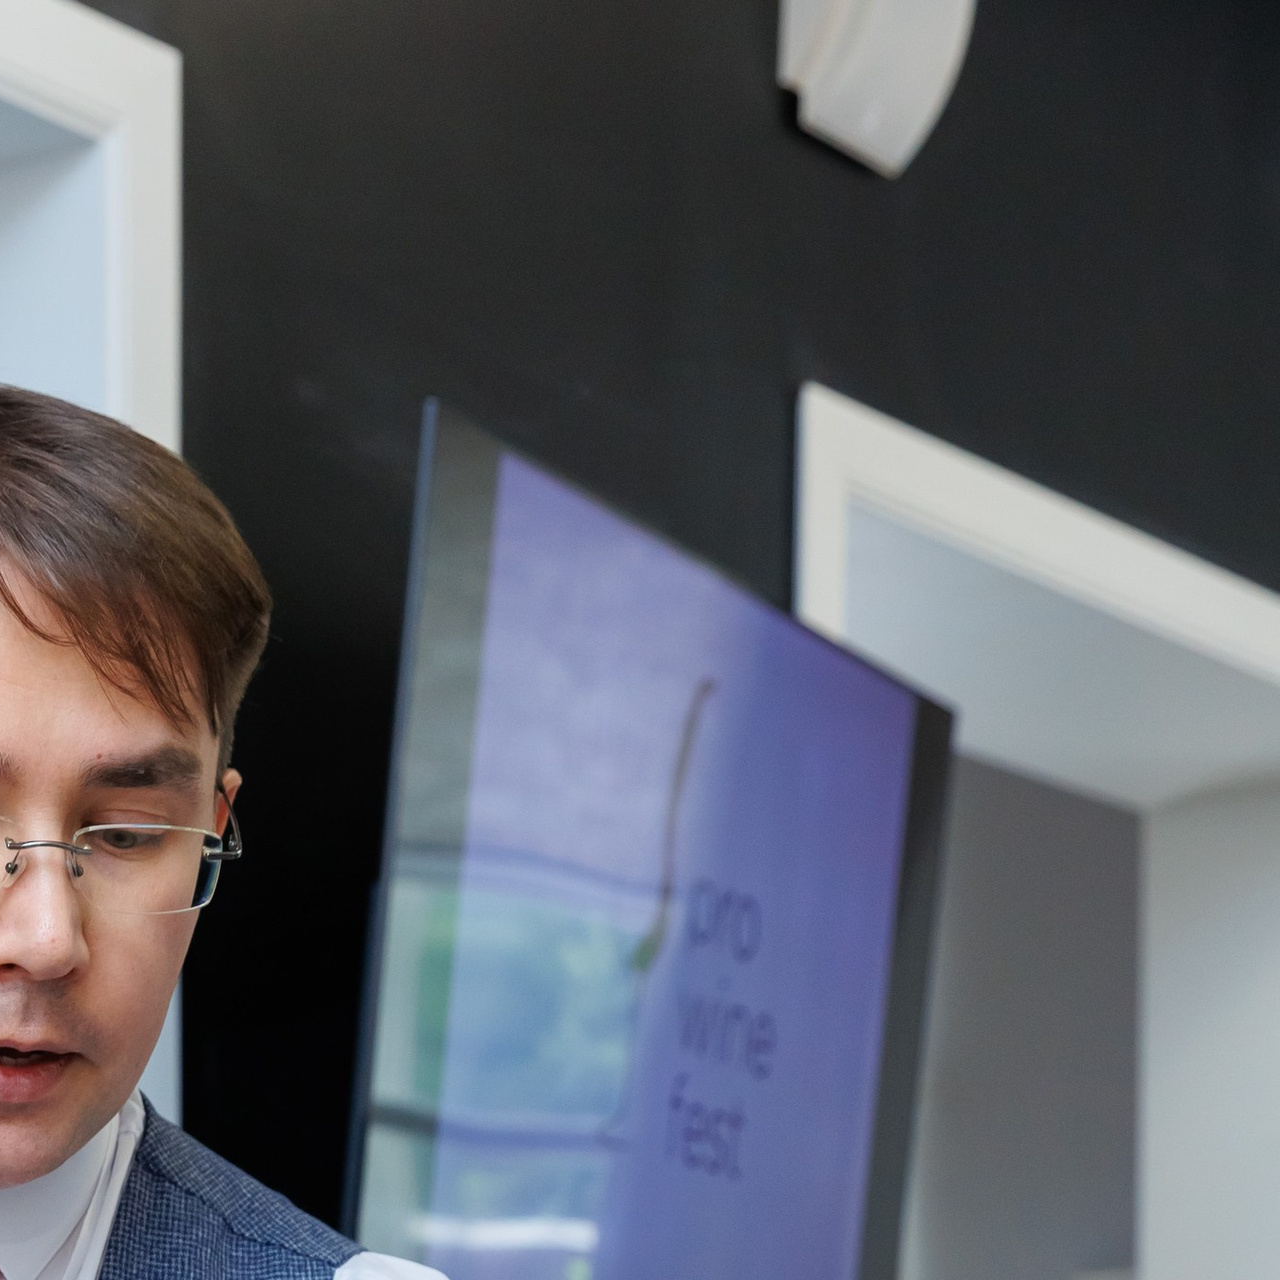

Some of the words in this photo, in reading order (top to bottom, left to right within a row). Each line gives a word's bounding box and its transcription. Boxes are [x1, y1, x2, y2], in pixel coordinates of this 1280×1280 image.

[685, 876, 763, 965] pro
[677, 976, 778, 1080] wine
[666, 1071, 744, 1180] fest
